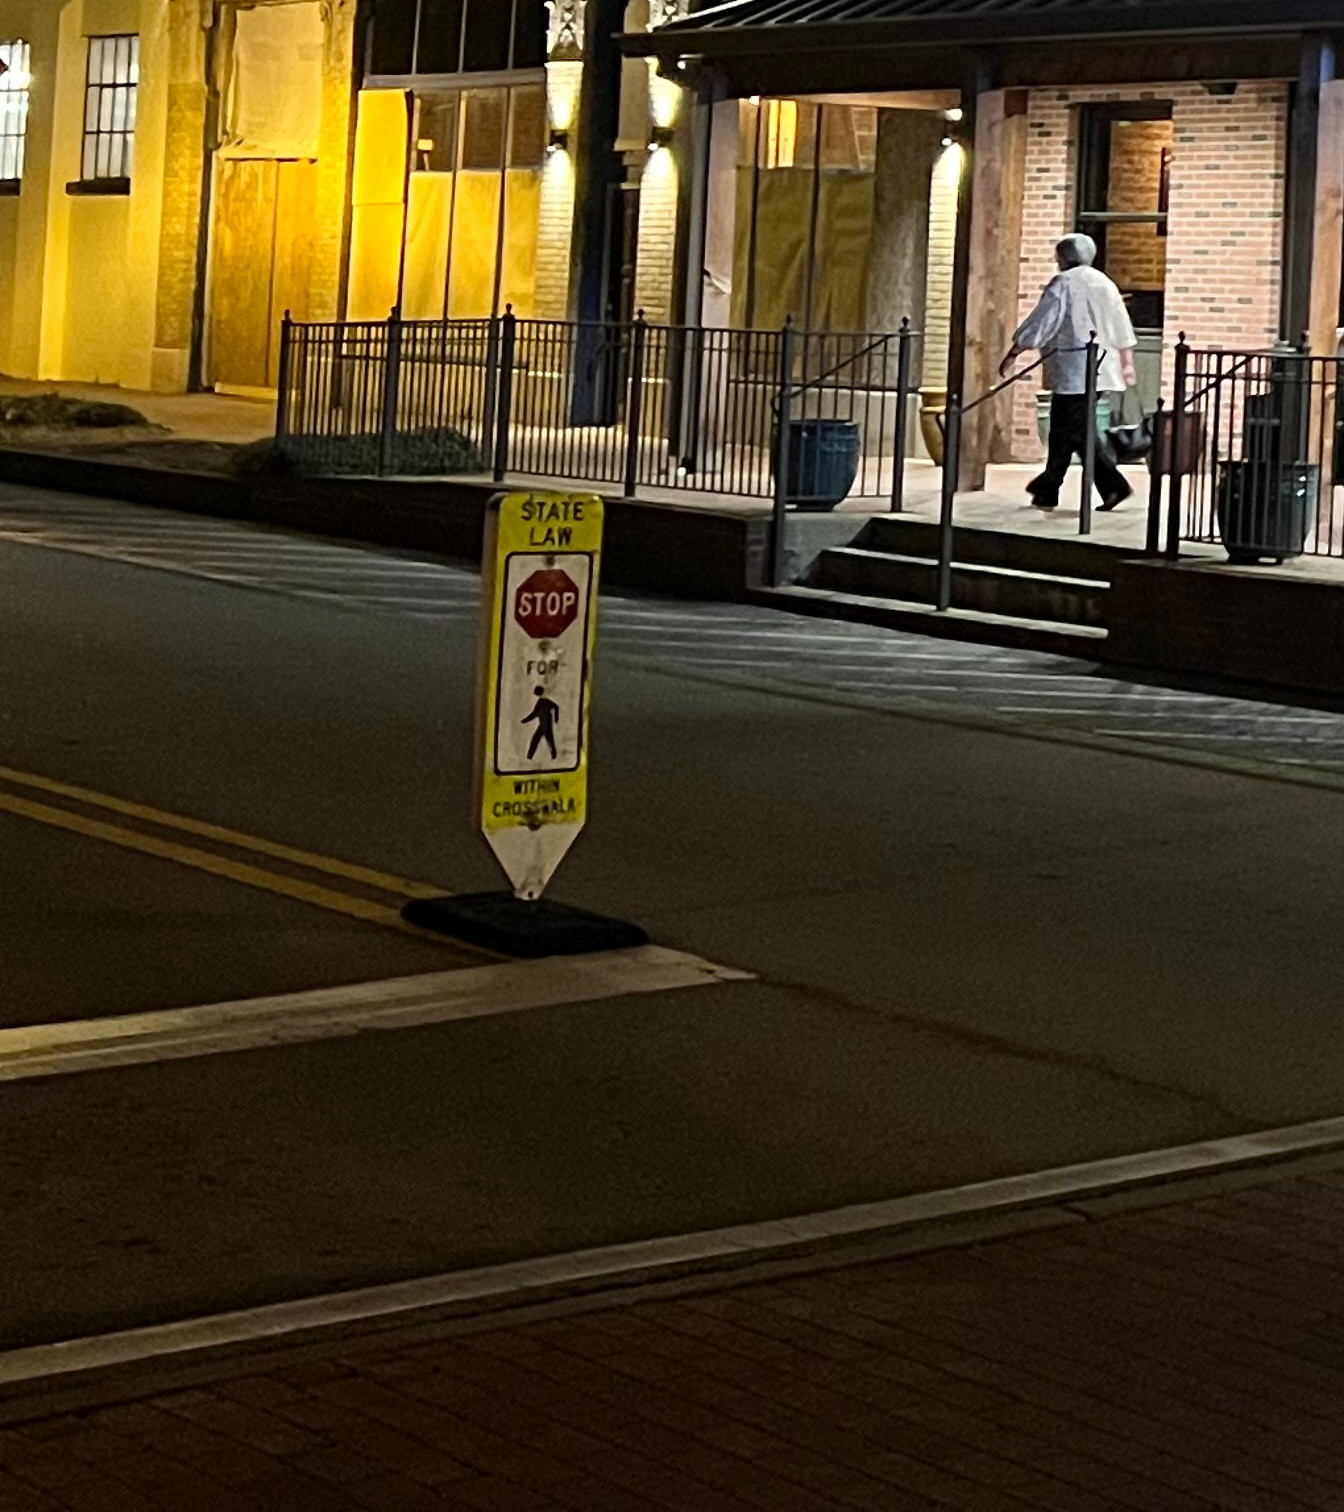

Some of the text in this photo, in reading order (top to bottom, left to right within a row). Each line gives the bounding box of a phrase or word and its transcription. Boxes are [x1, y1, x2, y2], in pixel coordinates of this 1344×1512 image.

[521, 501, 585, 522] STATE
[529, 526, 573, 547] LAW
[518, 591, 576, 617] STOP
[526, 659, 560, 677] FOR
